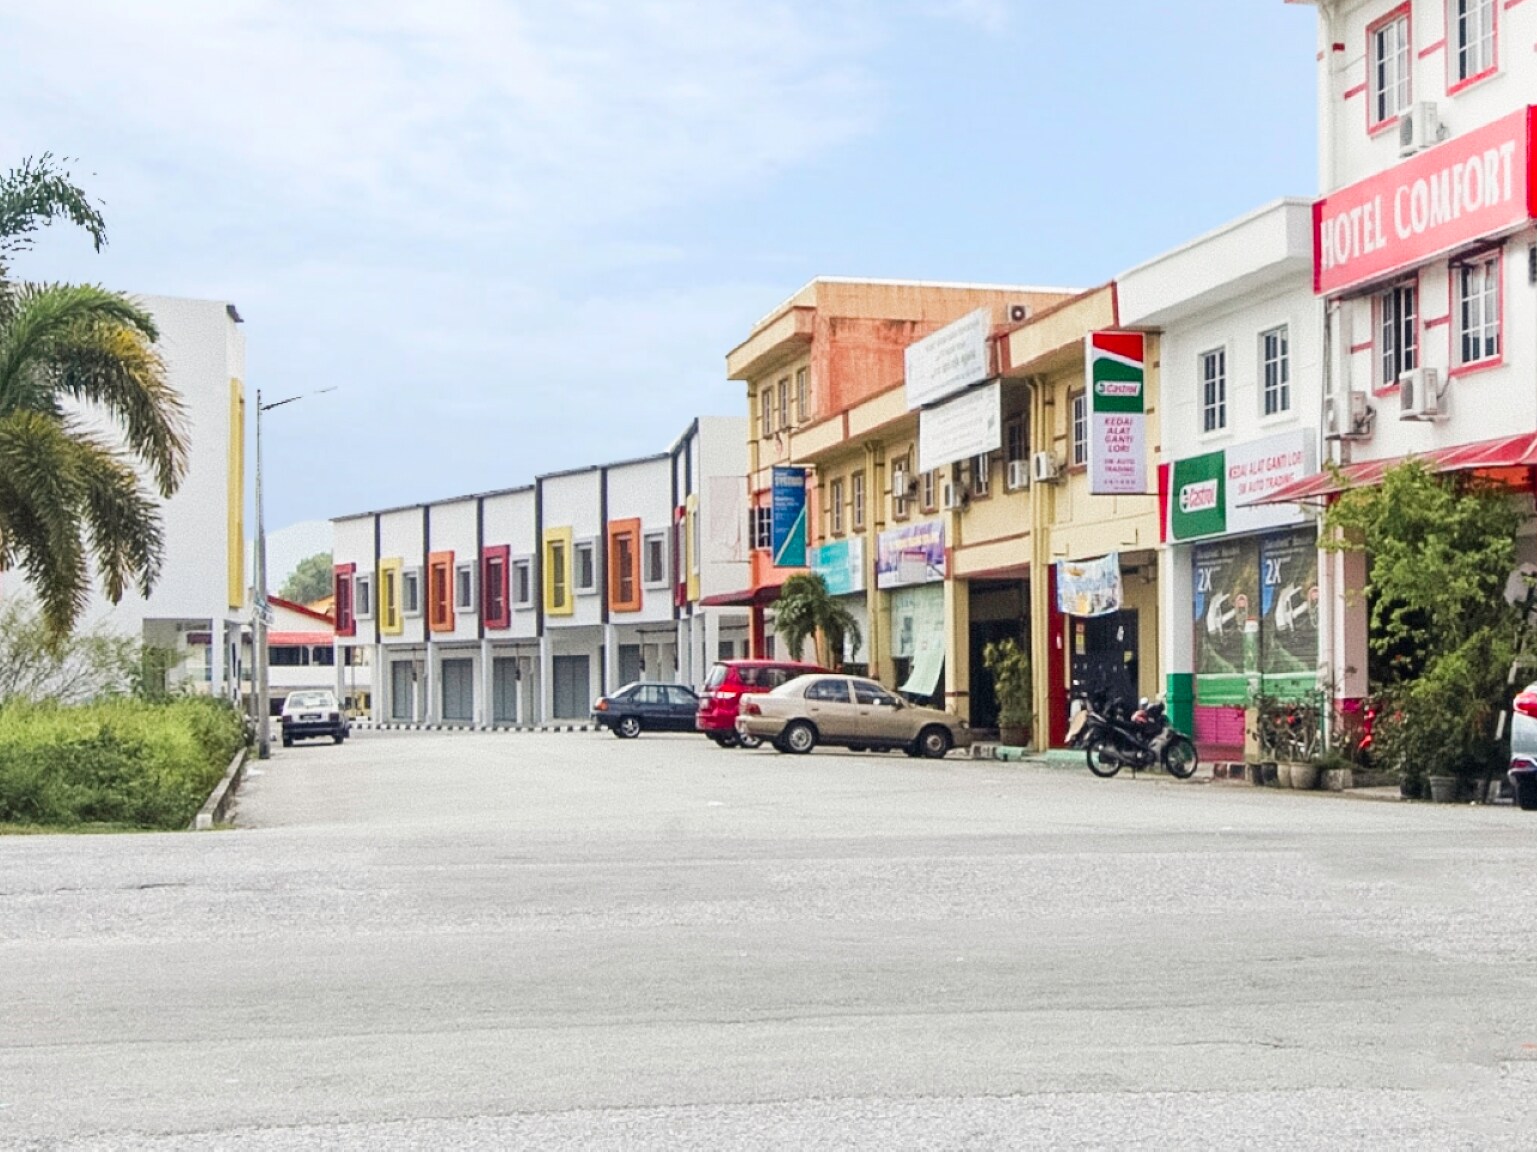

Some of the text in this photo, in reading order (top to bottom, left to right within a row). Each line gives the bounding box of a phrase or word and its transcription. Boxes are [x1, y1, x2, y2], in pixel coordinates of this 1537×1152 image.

[1320, 140, 1516, 271] HOTEL COMFORT
[1104, 417, 1133, 426] KEDAI
[1104, 435, 1133, 443] GANTI
[1107, 427, 1131, 435] ALAT
[1198, 567, 1213, 592] 2X
[1265, 557, 1282, 585] 2X
